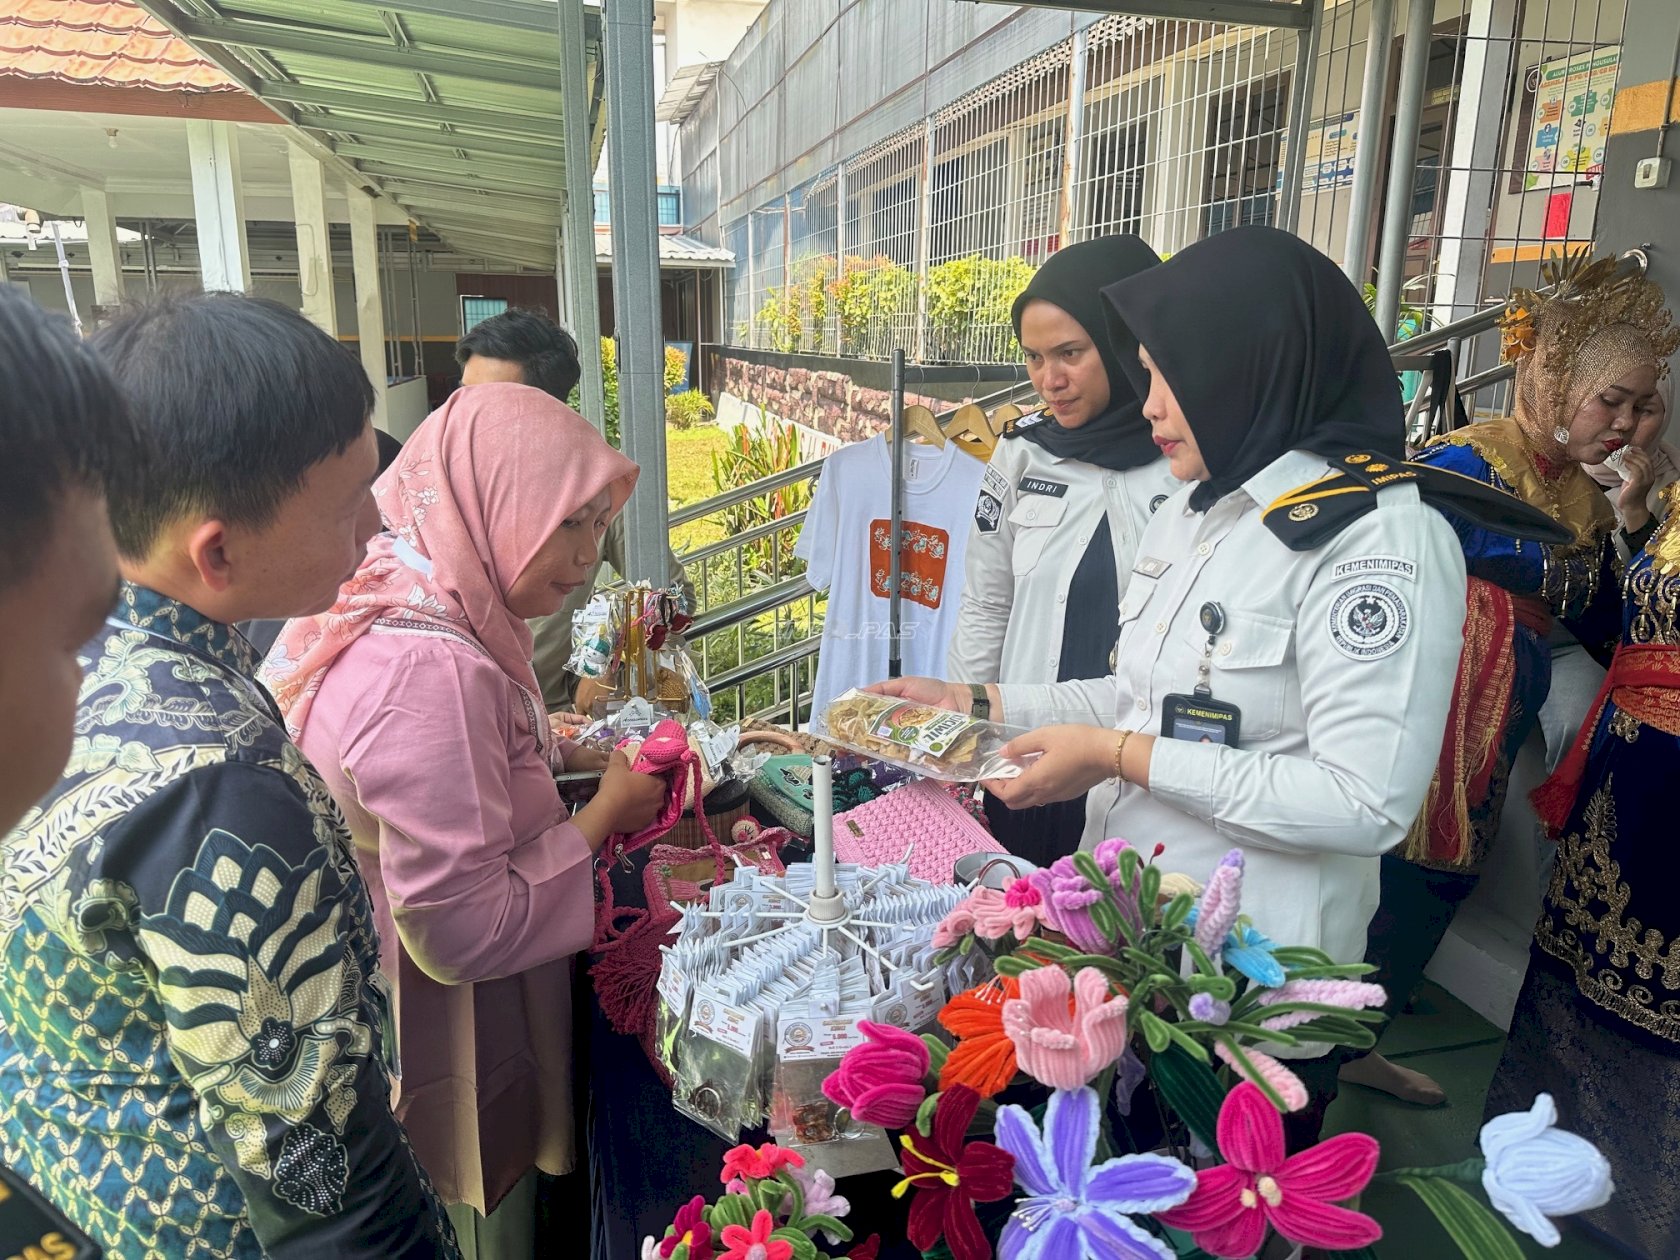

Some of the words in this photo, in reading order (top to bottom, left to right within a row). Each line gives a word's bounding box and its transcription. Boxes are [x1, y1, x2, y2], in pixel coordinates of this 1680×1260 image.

[1026, 481, 1058, 493] INDRI
[1335, 558, 1413, 576] KEMENIMIPAS
[1186, 708, 1233, 721] KEMENIMIPAS
